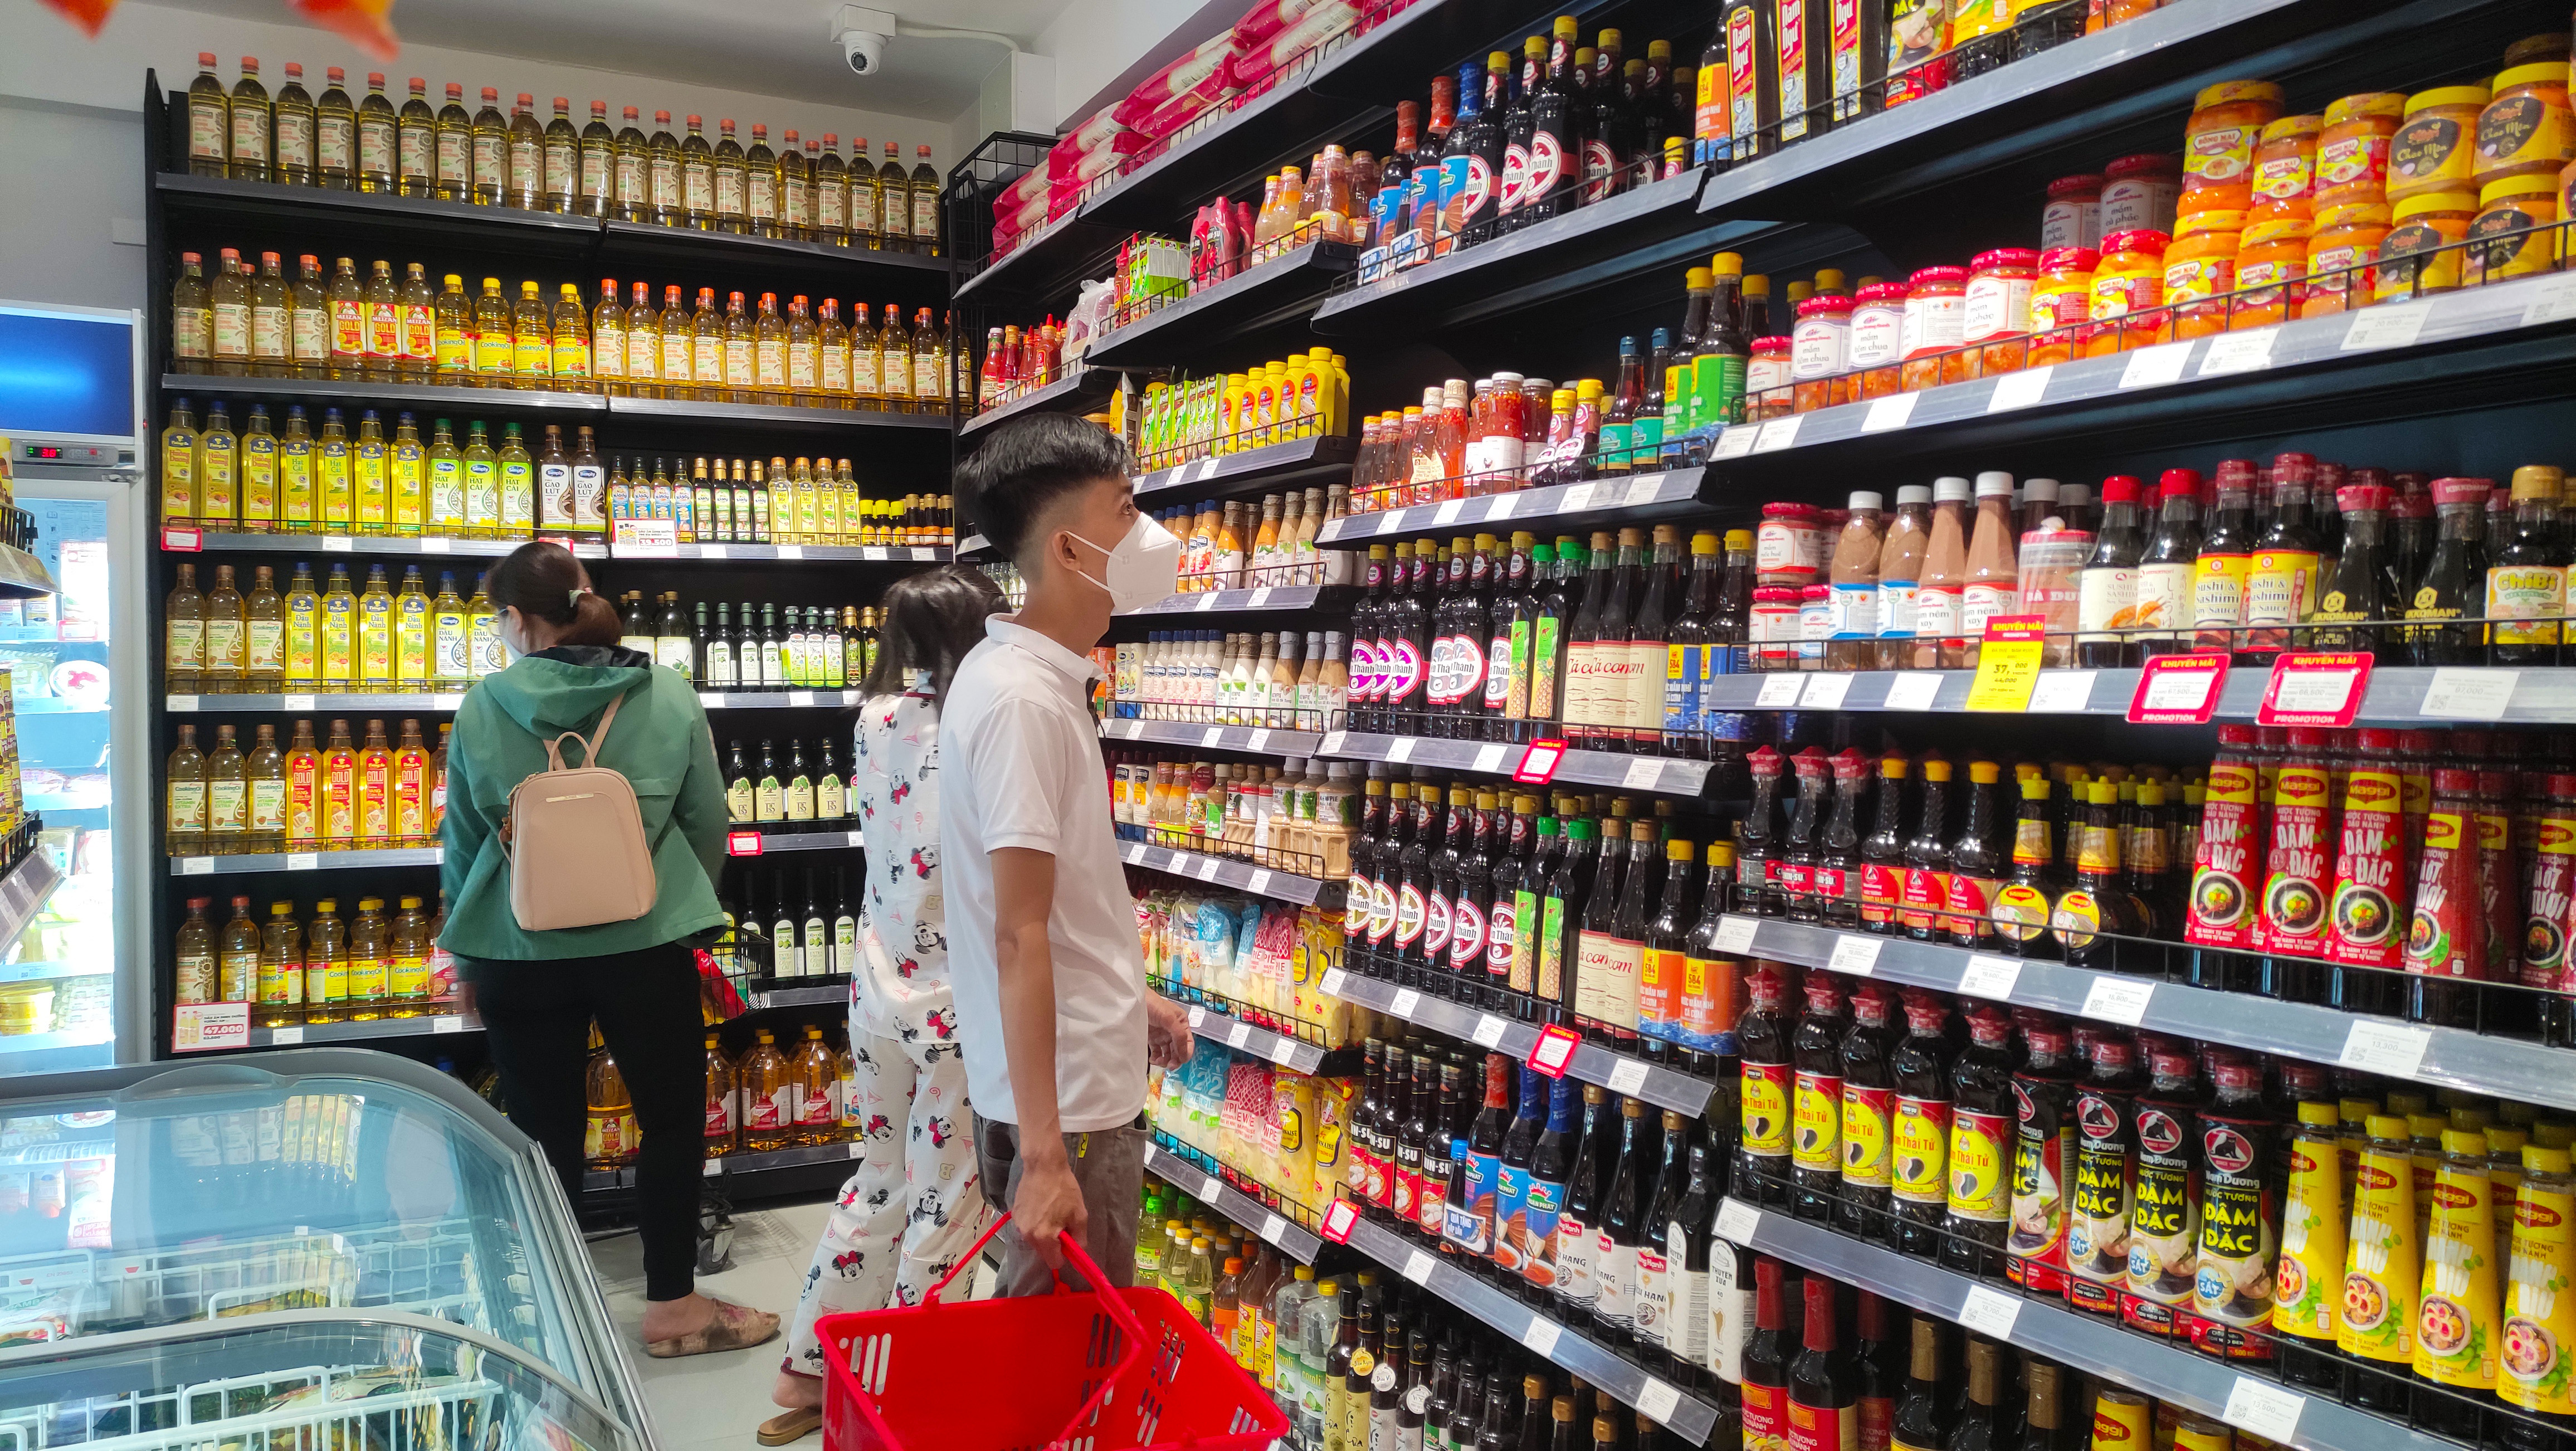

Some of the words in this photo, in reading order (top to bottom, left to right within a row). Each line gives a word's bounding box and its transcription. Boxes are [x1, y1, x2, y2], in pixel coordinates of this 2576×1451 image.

[339, 320, 360, 332] GOLD
[374, 323, 396, 333] GOLD
[409, 324, 430, 335] GOLD
[2274, 715, 2336, 724] PROMOTION
